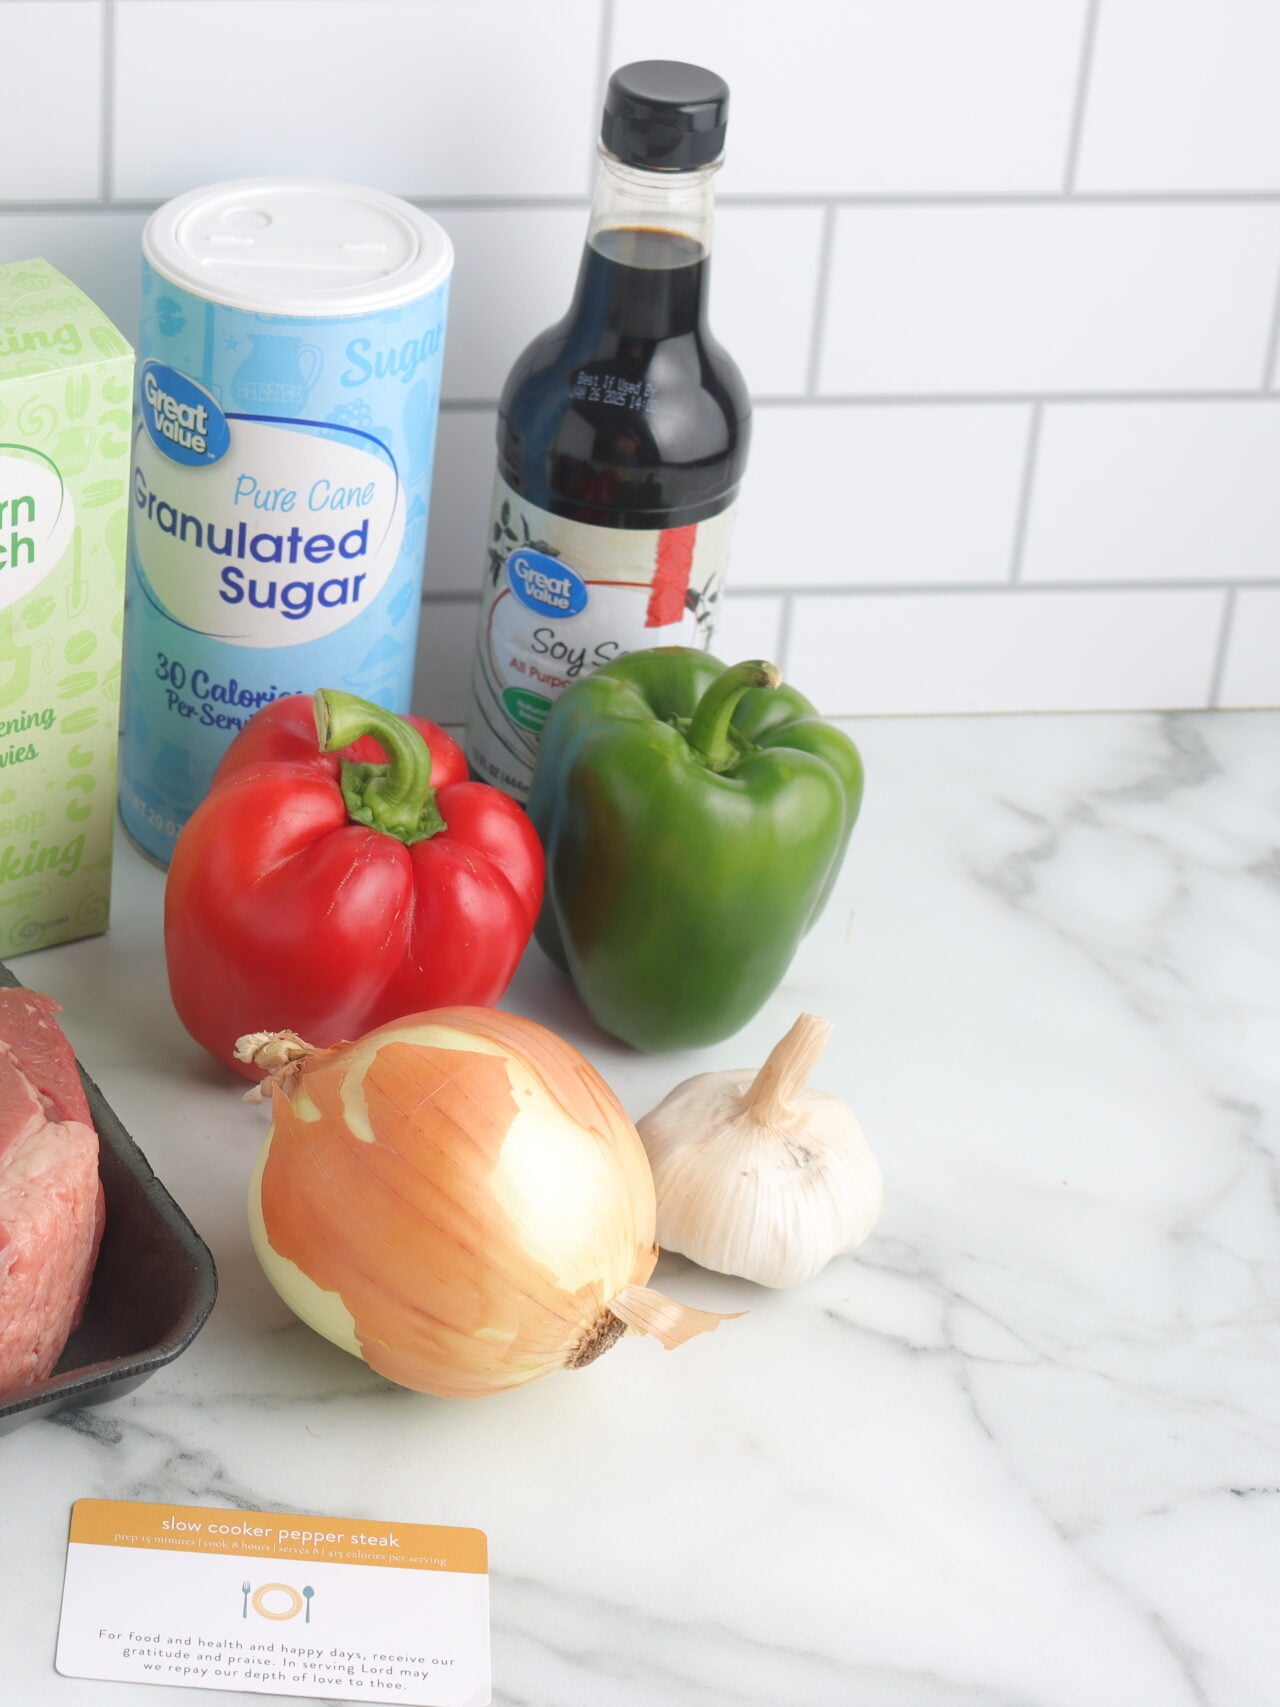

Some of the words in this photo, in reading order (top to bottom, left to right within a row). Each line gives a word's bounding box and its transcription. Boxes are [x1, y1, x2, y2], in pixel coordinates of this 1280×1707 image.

[144, 372, 209, 435] Great
[154, 411, 207, 454] Value
[234, 473, 296, 513] Pure
[308, 479, 375, 512] Cane
[135, 466, 369, 564] Granulated
[219, 566, 367, 620] Sugar
[515, 558, 572, 598] Great
[524, 581, 570, 610] Value
[531, 628, 586, 677] Soy
[155, 652, 186, 690] 30
[191, 669, 303, 709] Calori
[510, 658, 526, 675] All
[529, 666, 572, 689] Purpo
[165, 689, 198, 719] Per
[199, 703, 254, 733] Serv
[114, 1533, 138, 1543] prep
[141, 1535, 152, 1544] 15
[154, 1536, 195, 1546] minutes
[204, 1539, 228, 1549] cook
[241, 1541, 271, 1552] hours
[278, 1546, 310, 1555] serves
[346, 1549, 386, 1561] calories
[389, 1554, 406, 1565] per
[409, 1555, 447, 1567] serving
[161, 1515, 202, 1532] slow
[208, 1522, 273, 1538] cooker
[278, 1528, 345, 1546] pepper
[351, 1532, 400, 1548] steak
[99, 1629, 122, 1641] For
[129, 1631, 160, 1643] food
[167, 1636, 192, 1646] and
[198, 1637, 243, 1650] health
[249, 1643, 274, 1652] and
[281, 1643, 323, 1659] happy
[330, 1648, 367, 1661] days,
[373, 1652, 426, 1664] receive
[431, 1657, 456, 1667] our
[122, 1647, 191, 1659] gratitude
[196, 1652, 222, 1662] and
[228, 1655, 277, 1667] praise.
[283, 1658, 296, 1668] In
[302, 1661, 356, 1675] serving
[361, 1664, 393, 1675] Lord
[400, 1668, 430, 1681] may
[143, 1663, 162, 1671] we
[168, 1665, 208, 1677] repay
[214, 1668, 238, 1677] our
[244, 1668, 286, 1683] depth
[292, 1673, 308, 1682] of
[313, 1674, 343, 1685] love
[349, 1678, 364, 1688] to
[370, 1679, 408, 1691] thee.
